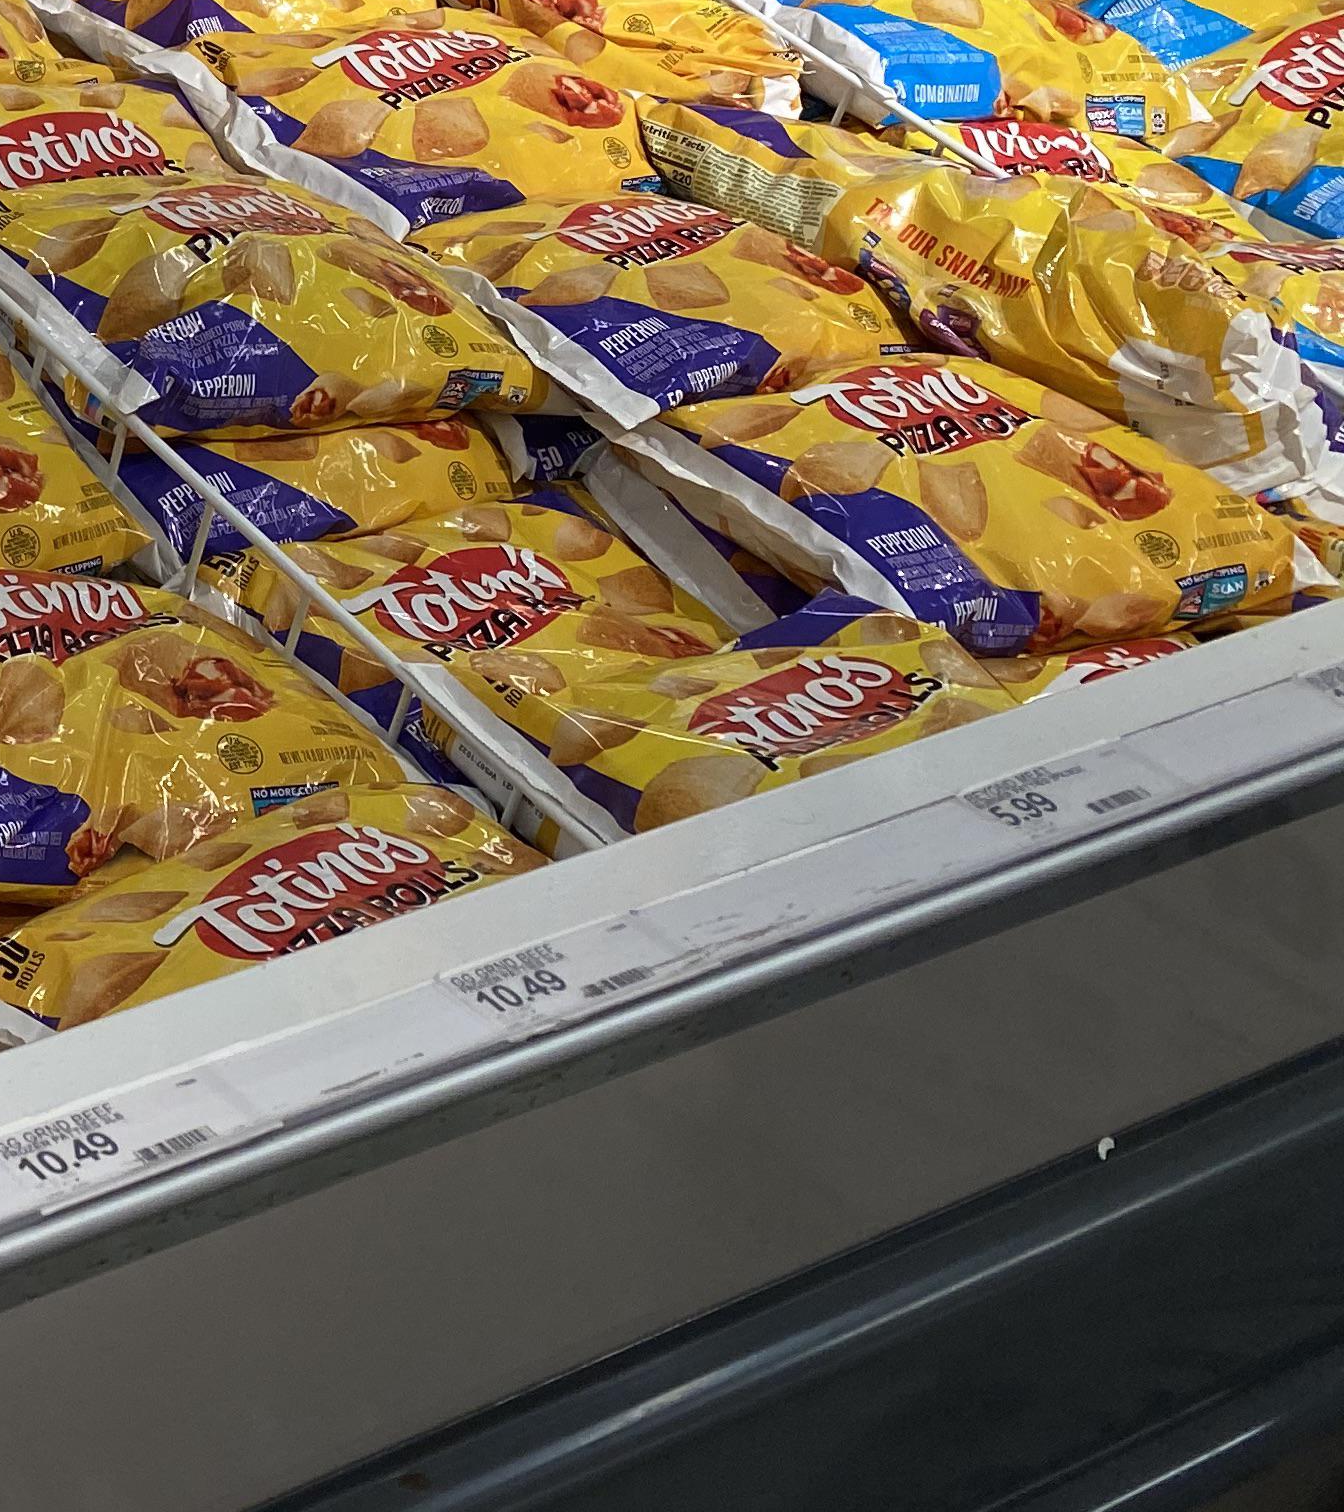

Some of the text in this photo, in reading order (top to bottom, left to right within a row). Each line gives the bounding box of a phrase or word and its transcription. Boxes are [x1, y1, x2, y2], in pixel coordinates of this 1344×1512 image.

[313, 27, 510, 88] Totino's
[377, 45, 533, 112] PIZZA ROLLS
[914, 84, 981, 106] COMBINATION
[1119, 107, 1143, 117] SCAN
[680, 132, 706, 152] Facts
[672, 169, 692, 187] 220
[603, 236, 686, 272] PIZZA
[897, 224, 993, 288] OUR SNACK
[598, 316, 672, 359] PEPPERONI
[875, 416, 966, 458] PIZZA
[538, 446, 564, 471] 50
[866, 524, 941, 558] PEPPERONI
[988, 790, 1058, 827] 5.99
[152, 820, 430, 954] Totino's
[14, 948, 47, 990] ROLLS
[476, 968, 568, 1013] 10.49
[18, 1130, 120, 1181] 10.49
